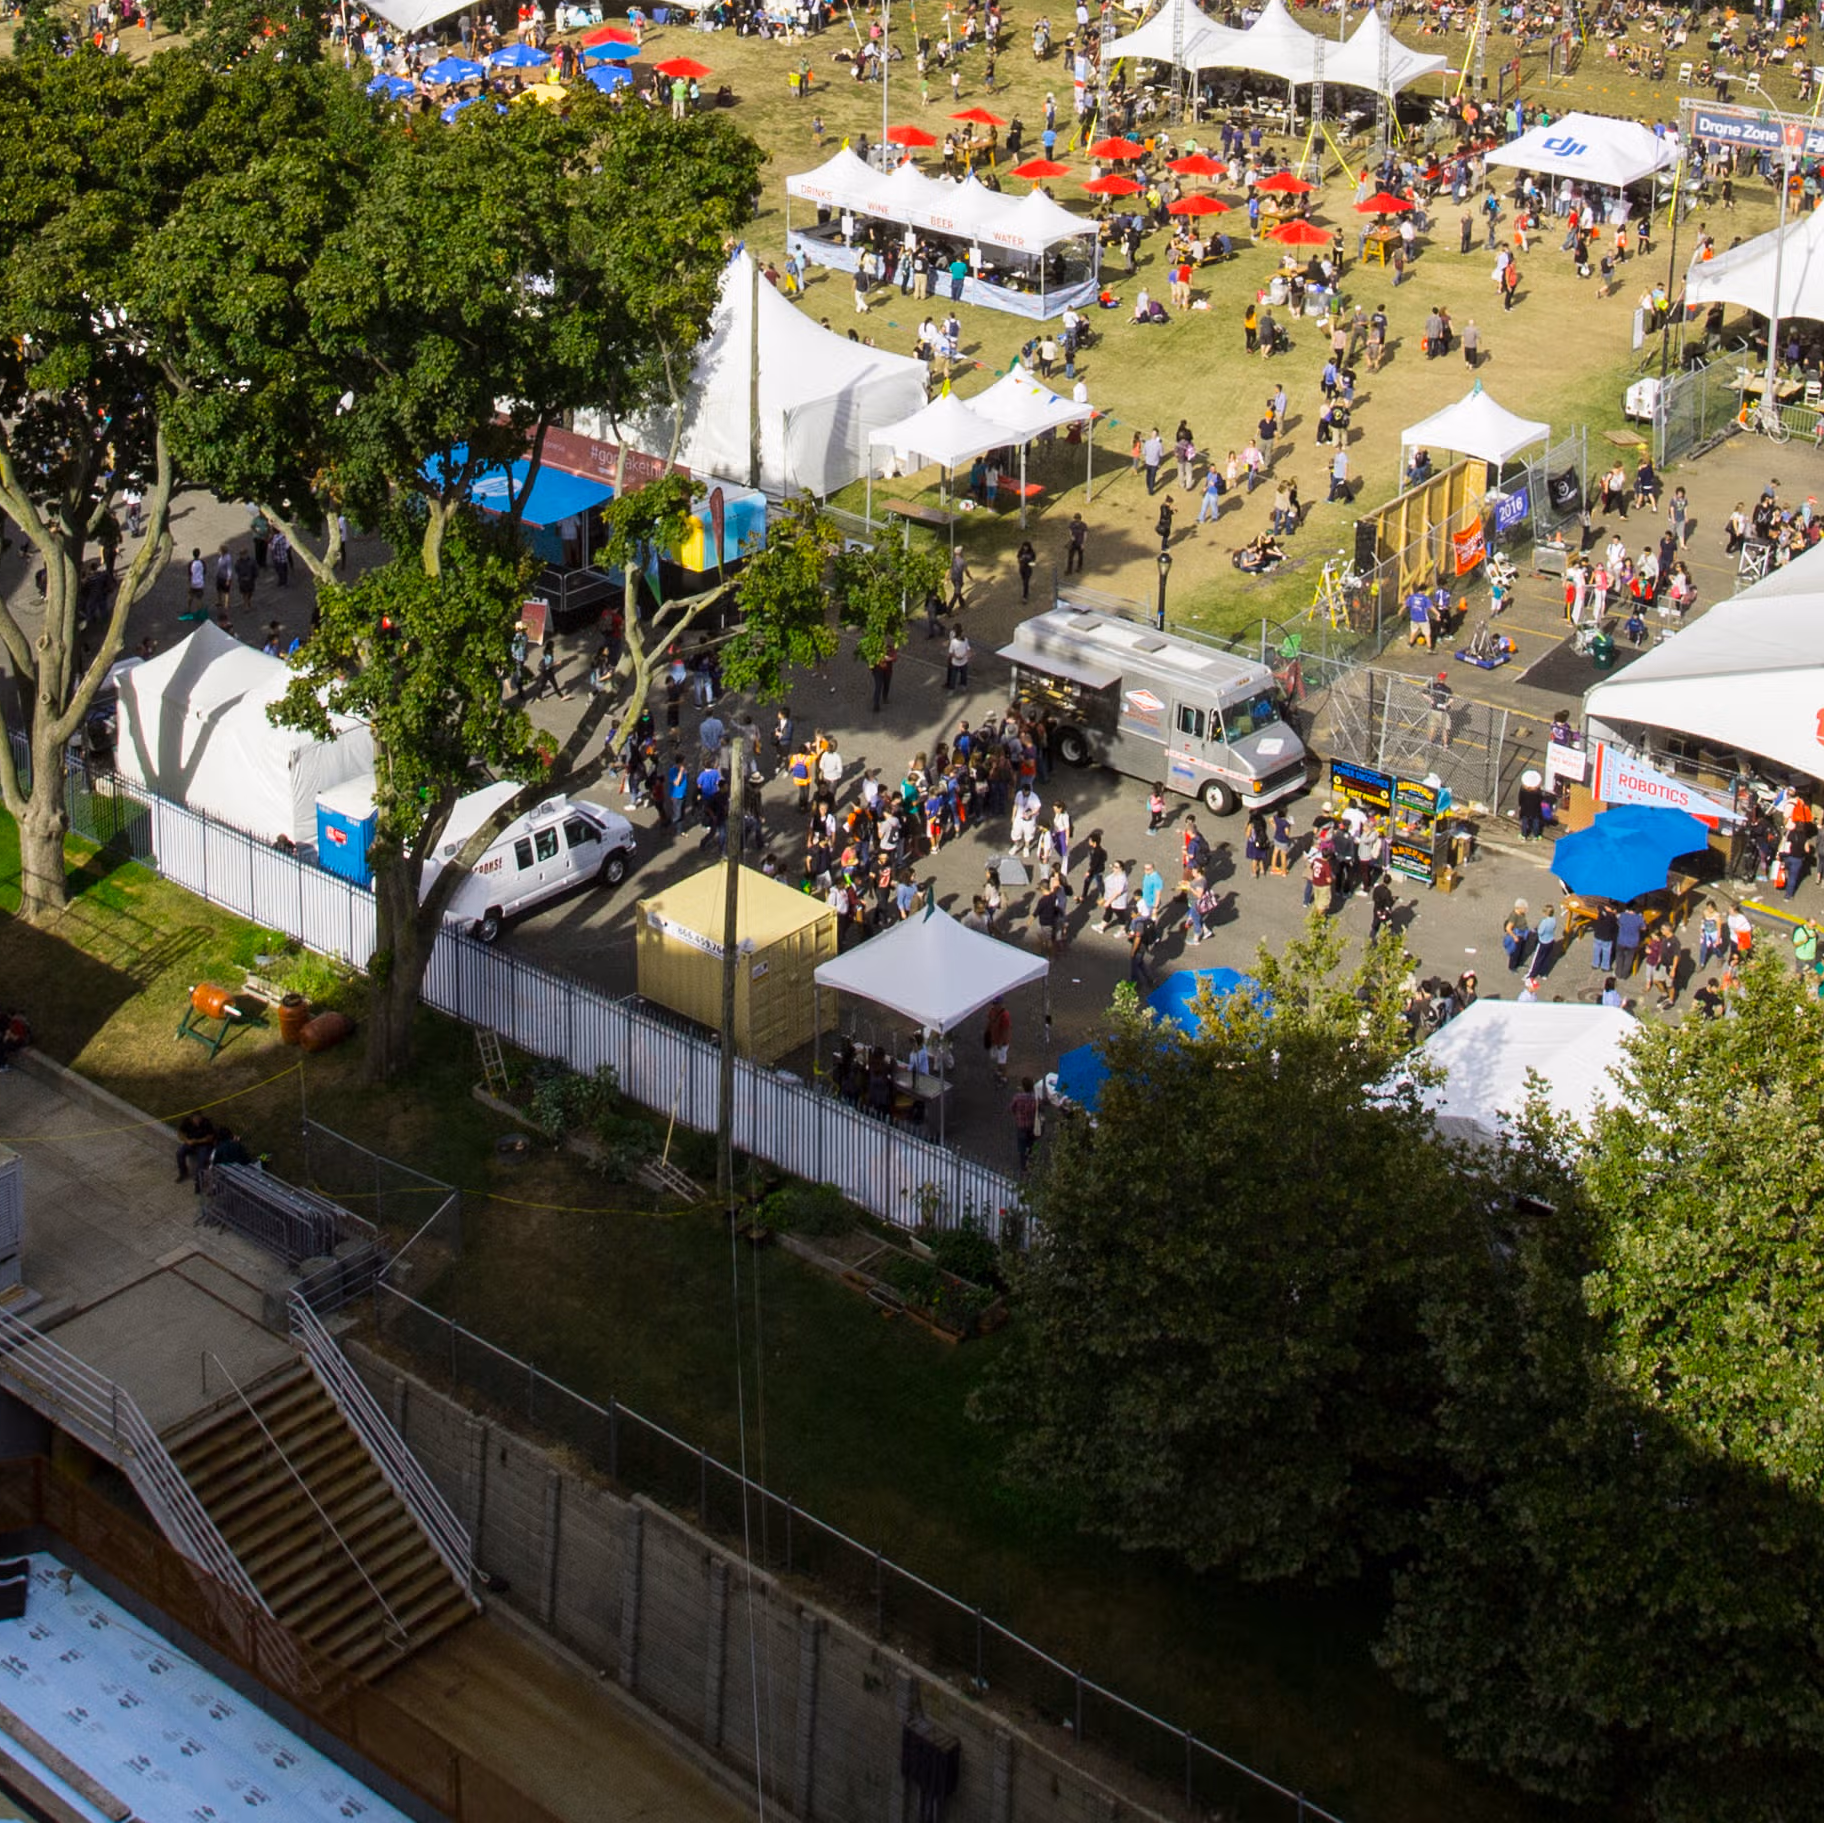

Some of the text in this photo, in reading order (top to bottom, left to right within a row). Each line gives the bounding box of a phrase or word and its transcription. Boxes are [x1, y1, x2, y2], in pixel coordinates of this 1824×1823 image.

[1699, 117, 1779, 143] Drone Zone
[1542, 136, 1589, 157] dji
[800, 184, 833, 201] DRINKS
[867, 201, 890, 216] WINE
[930, 215, 954, 230] BEER
[993, 231, 1025, 247] WATER
[1333, 765, 1356, 778] POWER
[1618, 773, 1690, 807] ROBOTICS
[1362, 792, 1391, 809] PRETZELS
